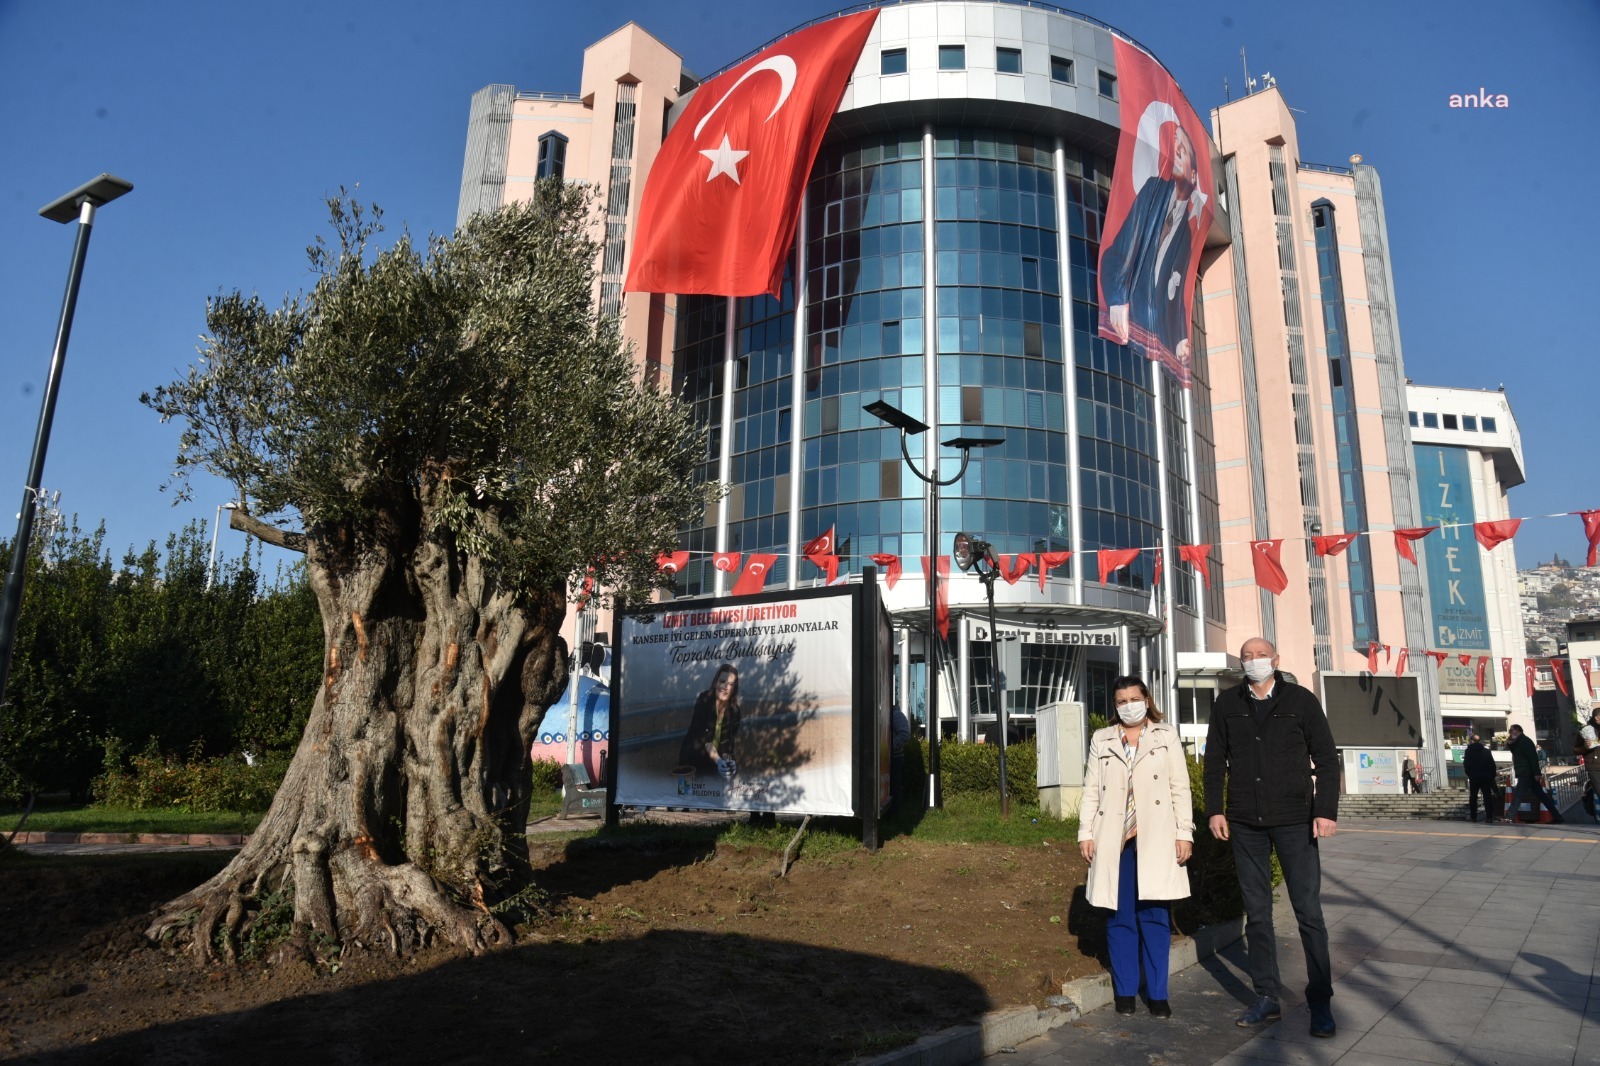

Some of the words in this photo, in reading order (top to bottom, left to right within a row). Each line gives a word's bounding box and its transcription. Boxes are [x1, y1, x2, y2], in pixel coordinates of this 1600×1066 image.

[663, 611, 689, 628] İZMİT
[691, 607, 744, 627] BELEDİYESİ
[746, 603, 798, 622] ÜRETİYOR
[633, 633, 669, 645] KANSERE
[671, 630, 683, 642] İYİ
[684, 630, 712, 641] GELEN
[713, 627, 742, 639] SÜPER
[743, 625, 776, 636] MEYVE
[777, 620, 839, 634] ARONYALAR
[995, 629, 1030, 642] ZMİT
[1035, 630, 1117, 646] BELEDİYESİ
[1456, 627, 1482, 639] İZMİT
[670, 644, 723, 668] Toprakla
[725, 640, 796, 663] Buluşuyor
[1445, 666, 1488, 678] TÜGV
